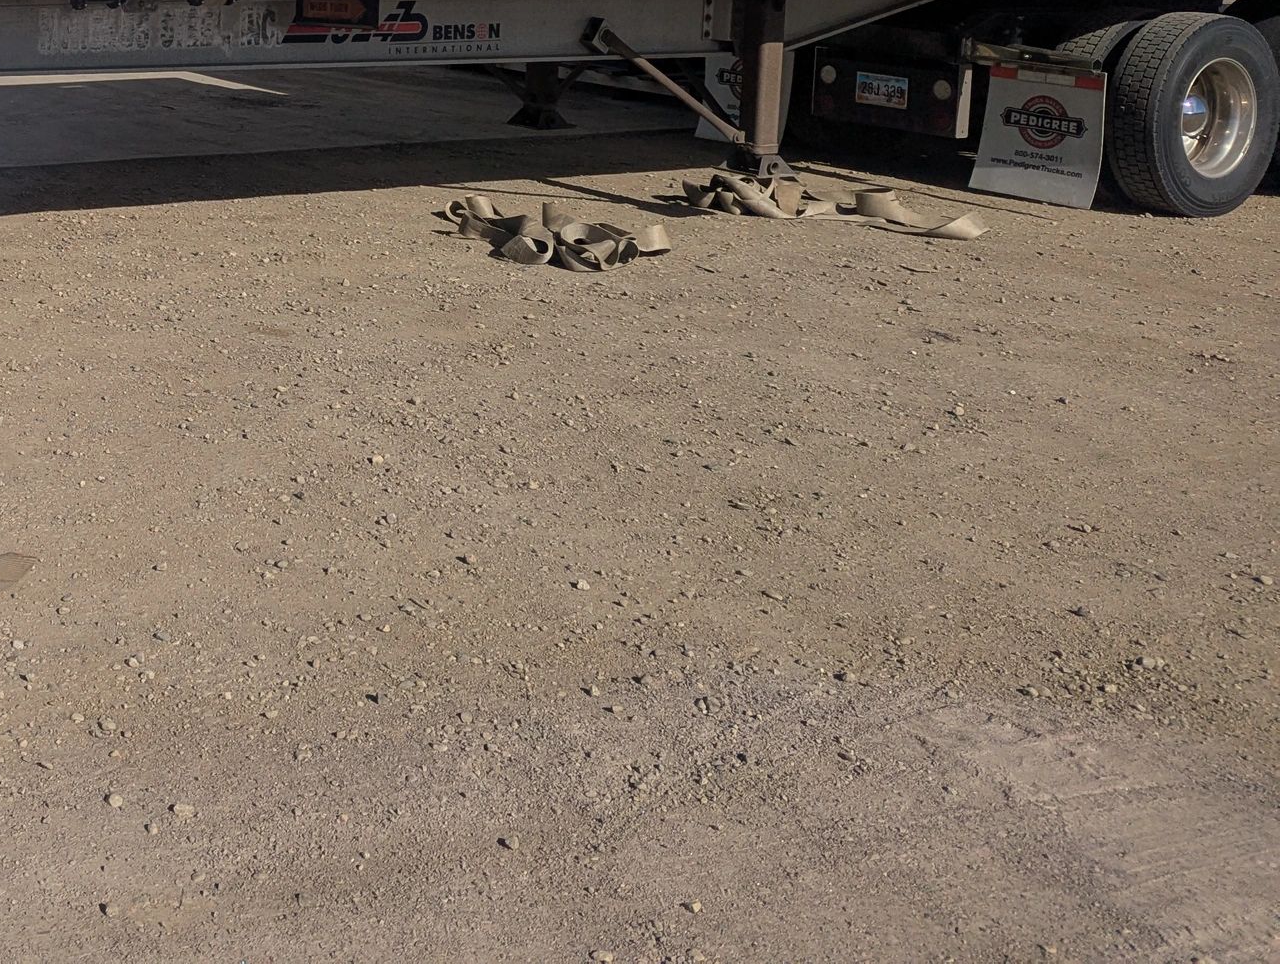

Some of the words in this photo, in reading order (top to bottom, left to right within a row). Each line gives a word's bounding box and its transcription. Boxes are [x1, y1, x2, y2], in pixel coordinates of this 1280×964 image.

[432, 23, 500, 40] BENSON
[388, 43, 501, 55] INTERNATIONAL
[1010, 112, 1078, 133] PEDIGREE
